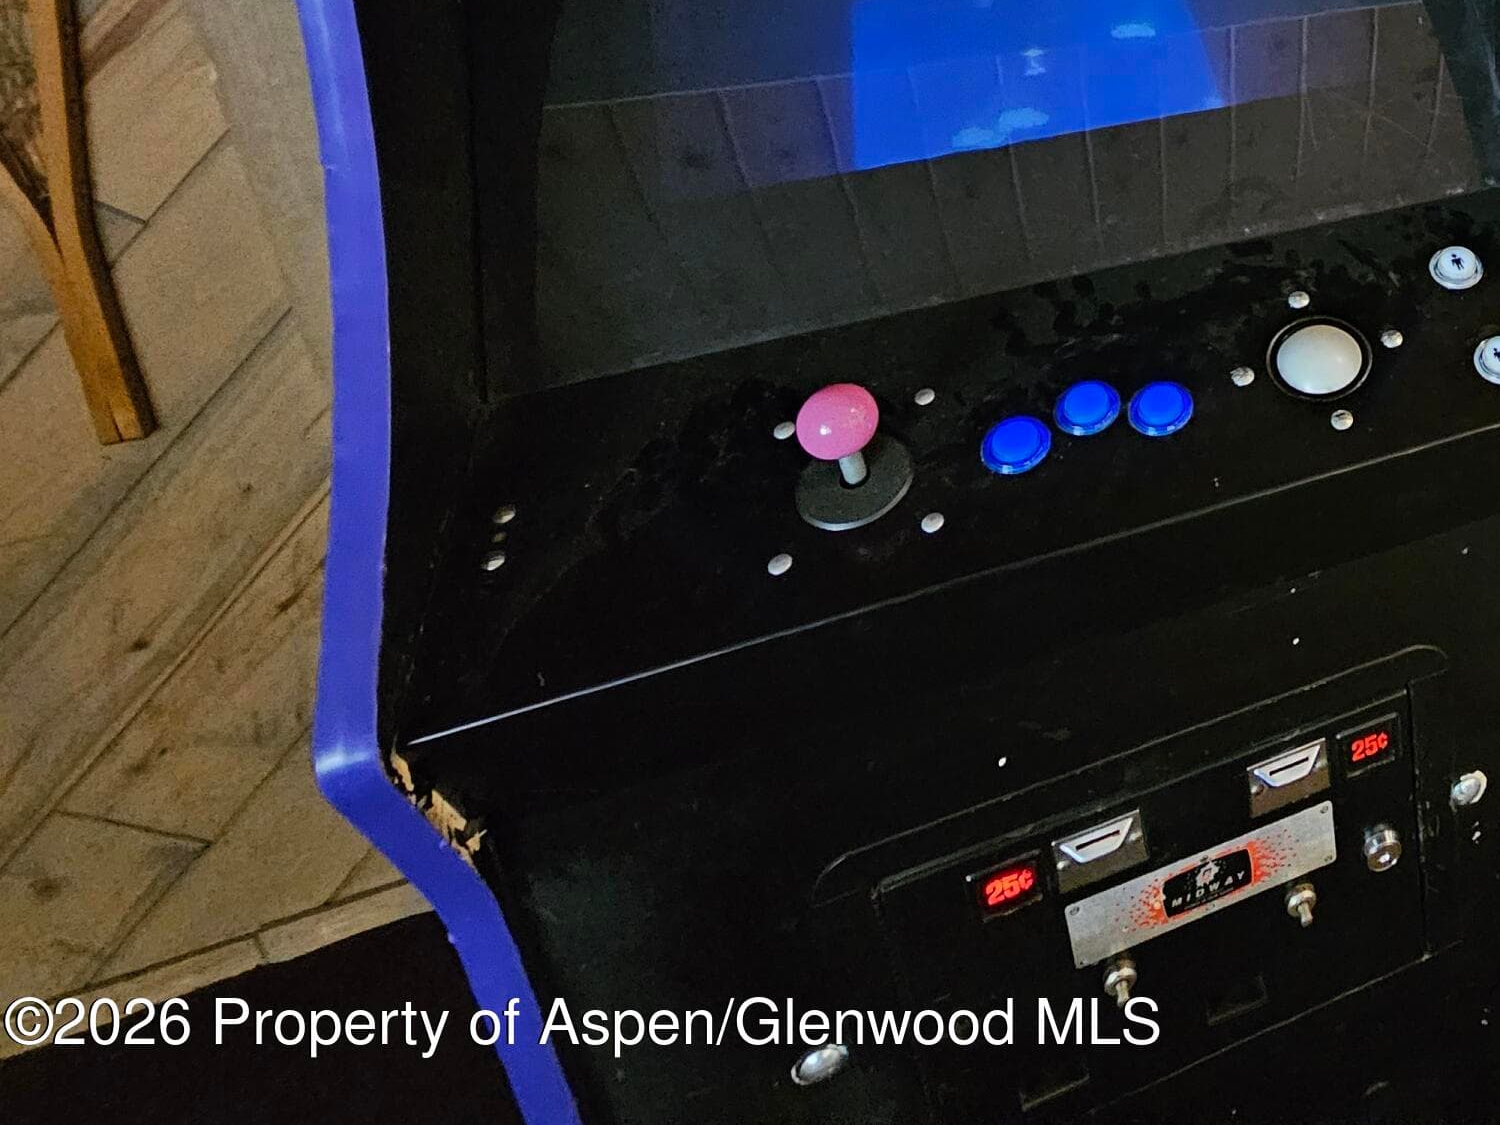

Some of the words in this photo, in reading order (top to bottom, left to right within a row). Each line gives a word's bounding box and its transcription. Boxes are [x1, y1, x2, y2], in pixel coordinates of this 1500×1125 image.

[1351, 731, 1389, 763] 25¢
[985, 868, 1034, 906] 25¢
[1171, 870, 1246, 908] MIDWAY
